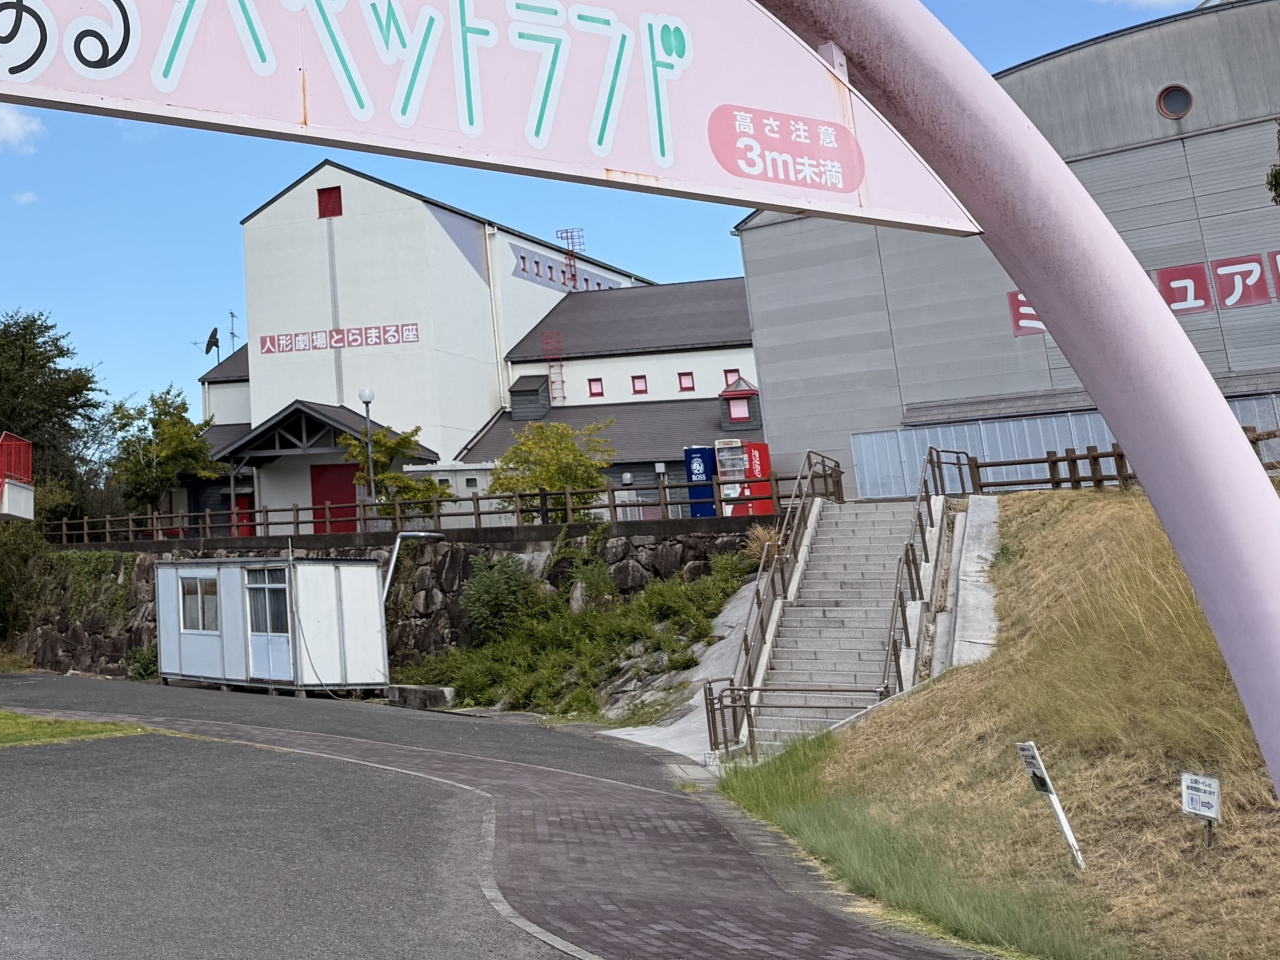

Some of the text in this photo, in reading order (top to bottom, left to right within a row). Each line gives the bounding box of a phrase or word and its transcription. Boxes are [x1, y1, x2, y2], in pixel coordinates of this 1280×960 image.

[733, 111, 838, 148] 高さ注意
[736, 137, 844, 189] 3m未満
[261, 324, 419, 354] 人形劇場とらまる座
